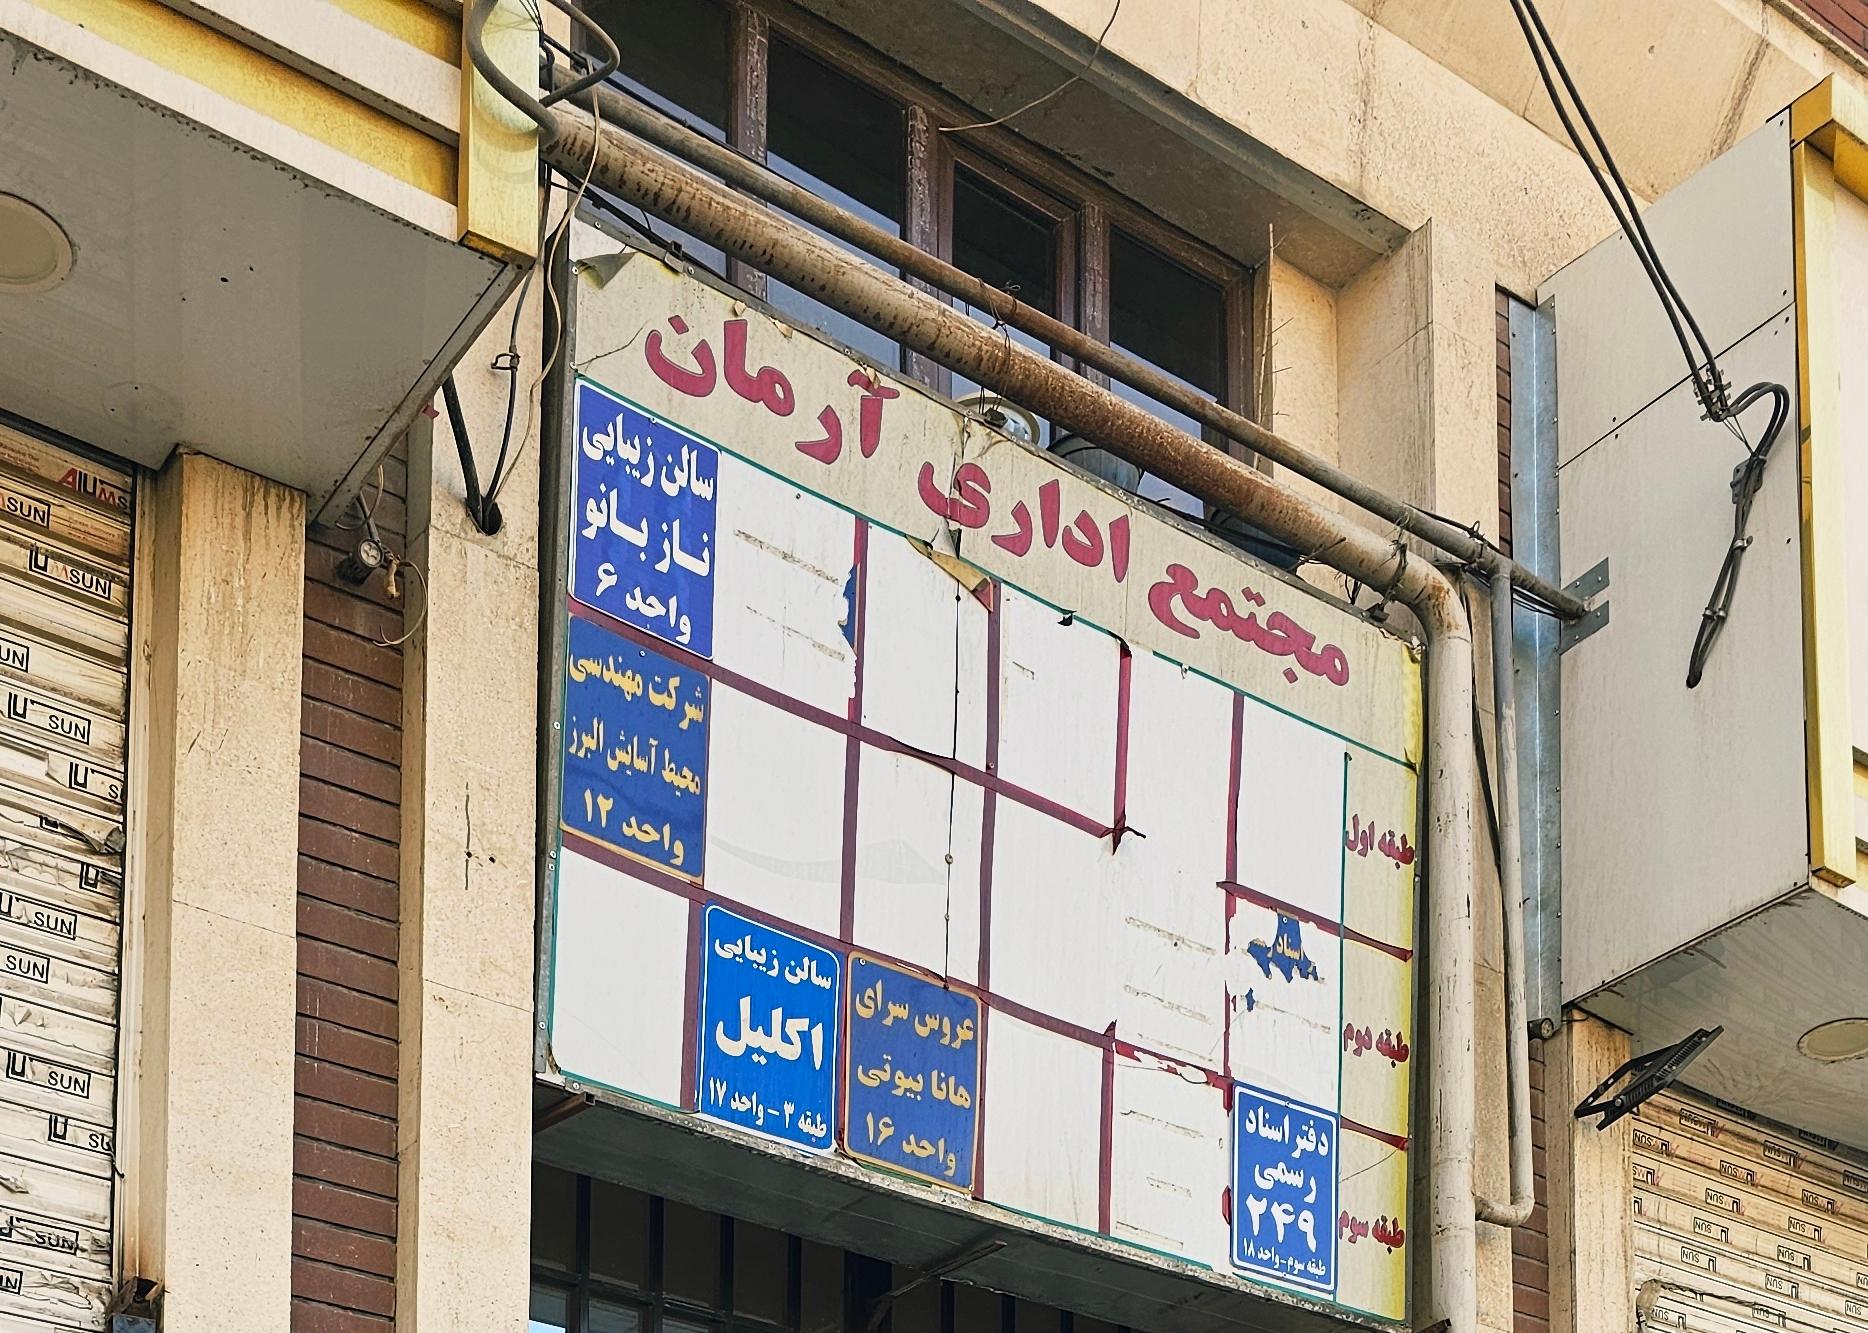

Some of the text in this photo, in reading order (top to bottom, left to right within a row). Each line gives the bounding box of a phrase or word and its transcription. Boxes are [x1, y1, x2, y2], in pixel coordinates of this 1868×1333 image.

[582, 413, 714, 501] سالن زیبایی
[645, 314, 1349, 687] مجتمع اداری آرمان
[582, 483, 710, 577] ناز بانو
[596, 562, 692, 644] واحد ۶
[0, 644, 25, 669] UN
[569, 654, 704, 730] شرکت مهندسی
[49, 714, 87, 741] SUN
[568, 715, 702, 797] محیط آسایش البرز
[583, 789, 684, 866] واحد ۱۲
[1344, 813, 1415, 870] طبقه اول
[34, 910, 73, 935] SUN
[5, 954, 46, 979] SUN
[714, 935, 832, 989] سالن زیبایی
[856, 979, 974, 1049] عروس سرای
[715, 995, 824, 1071] اکلیل
[1343, 1023, 1409, 1068] طبقه دوم
[48, 1070, 86, 1094] SUN
[709, 1076, 727, 1108] ۱۷
[857, 1054, 971, 1109] هانا بیوتی
[730, 1092, 764, 1126] واحد
[783, 1101, 795, 1129] ۳
[89, 1132, 112, 1151] SU
[798, 1111, 827, 1142] طبقه
[1245, 1106, 1329, 1159] دفتر اسناد
[866, 1112, 956, 1177] واحد ۱۶
[1254, 1161, 1317, 1204] رسمی
[1707, 1191, 1723, 1204] SUN
[1245, 1193, 1317, 1253] ۲۴۹
[1338, 1210, 1405, 1254] طبقه سوم
[1695, 1220, 1711, 1233] SUN
[1790, 1219, 1805, 1232] SUN
[35, 1230, 75, 1250] SUN
[1243, 1237, 1255, 1257] ۱۸
[1683, 1248, 1699, 1263] SUN
[1780, 1248, 1794, 1261] SUN
[1306, 1259, 1326, 1279] طبقه
[1767, 1276, 1783, 1289] SUN
[1846, 1302, 1861, 1315] SUN
